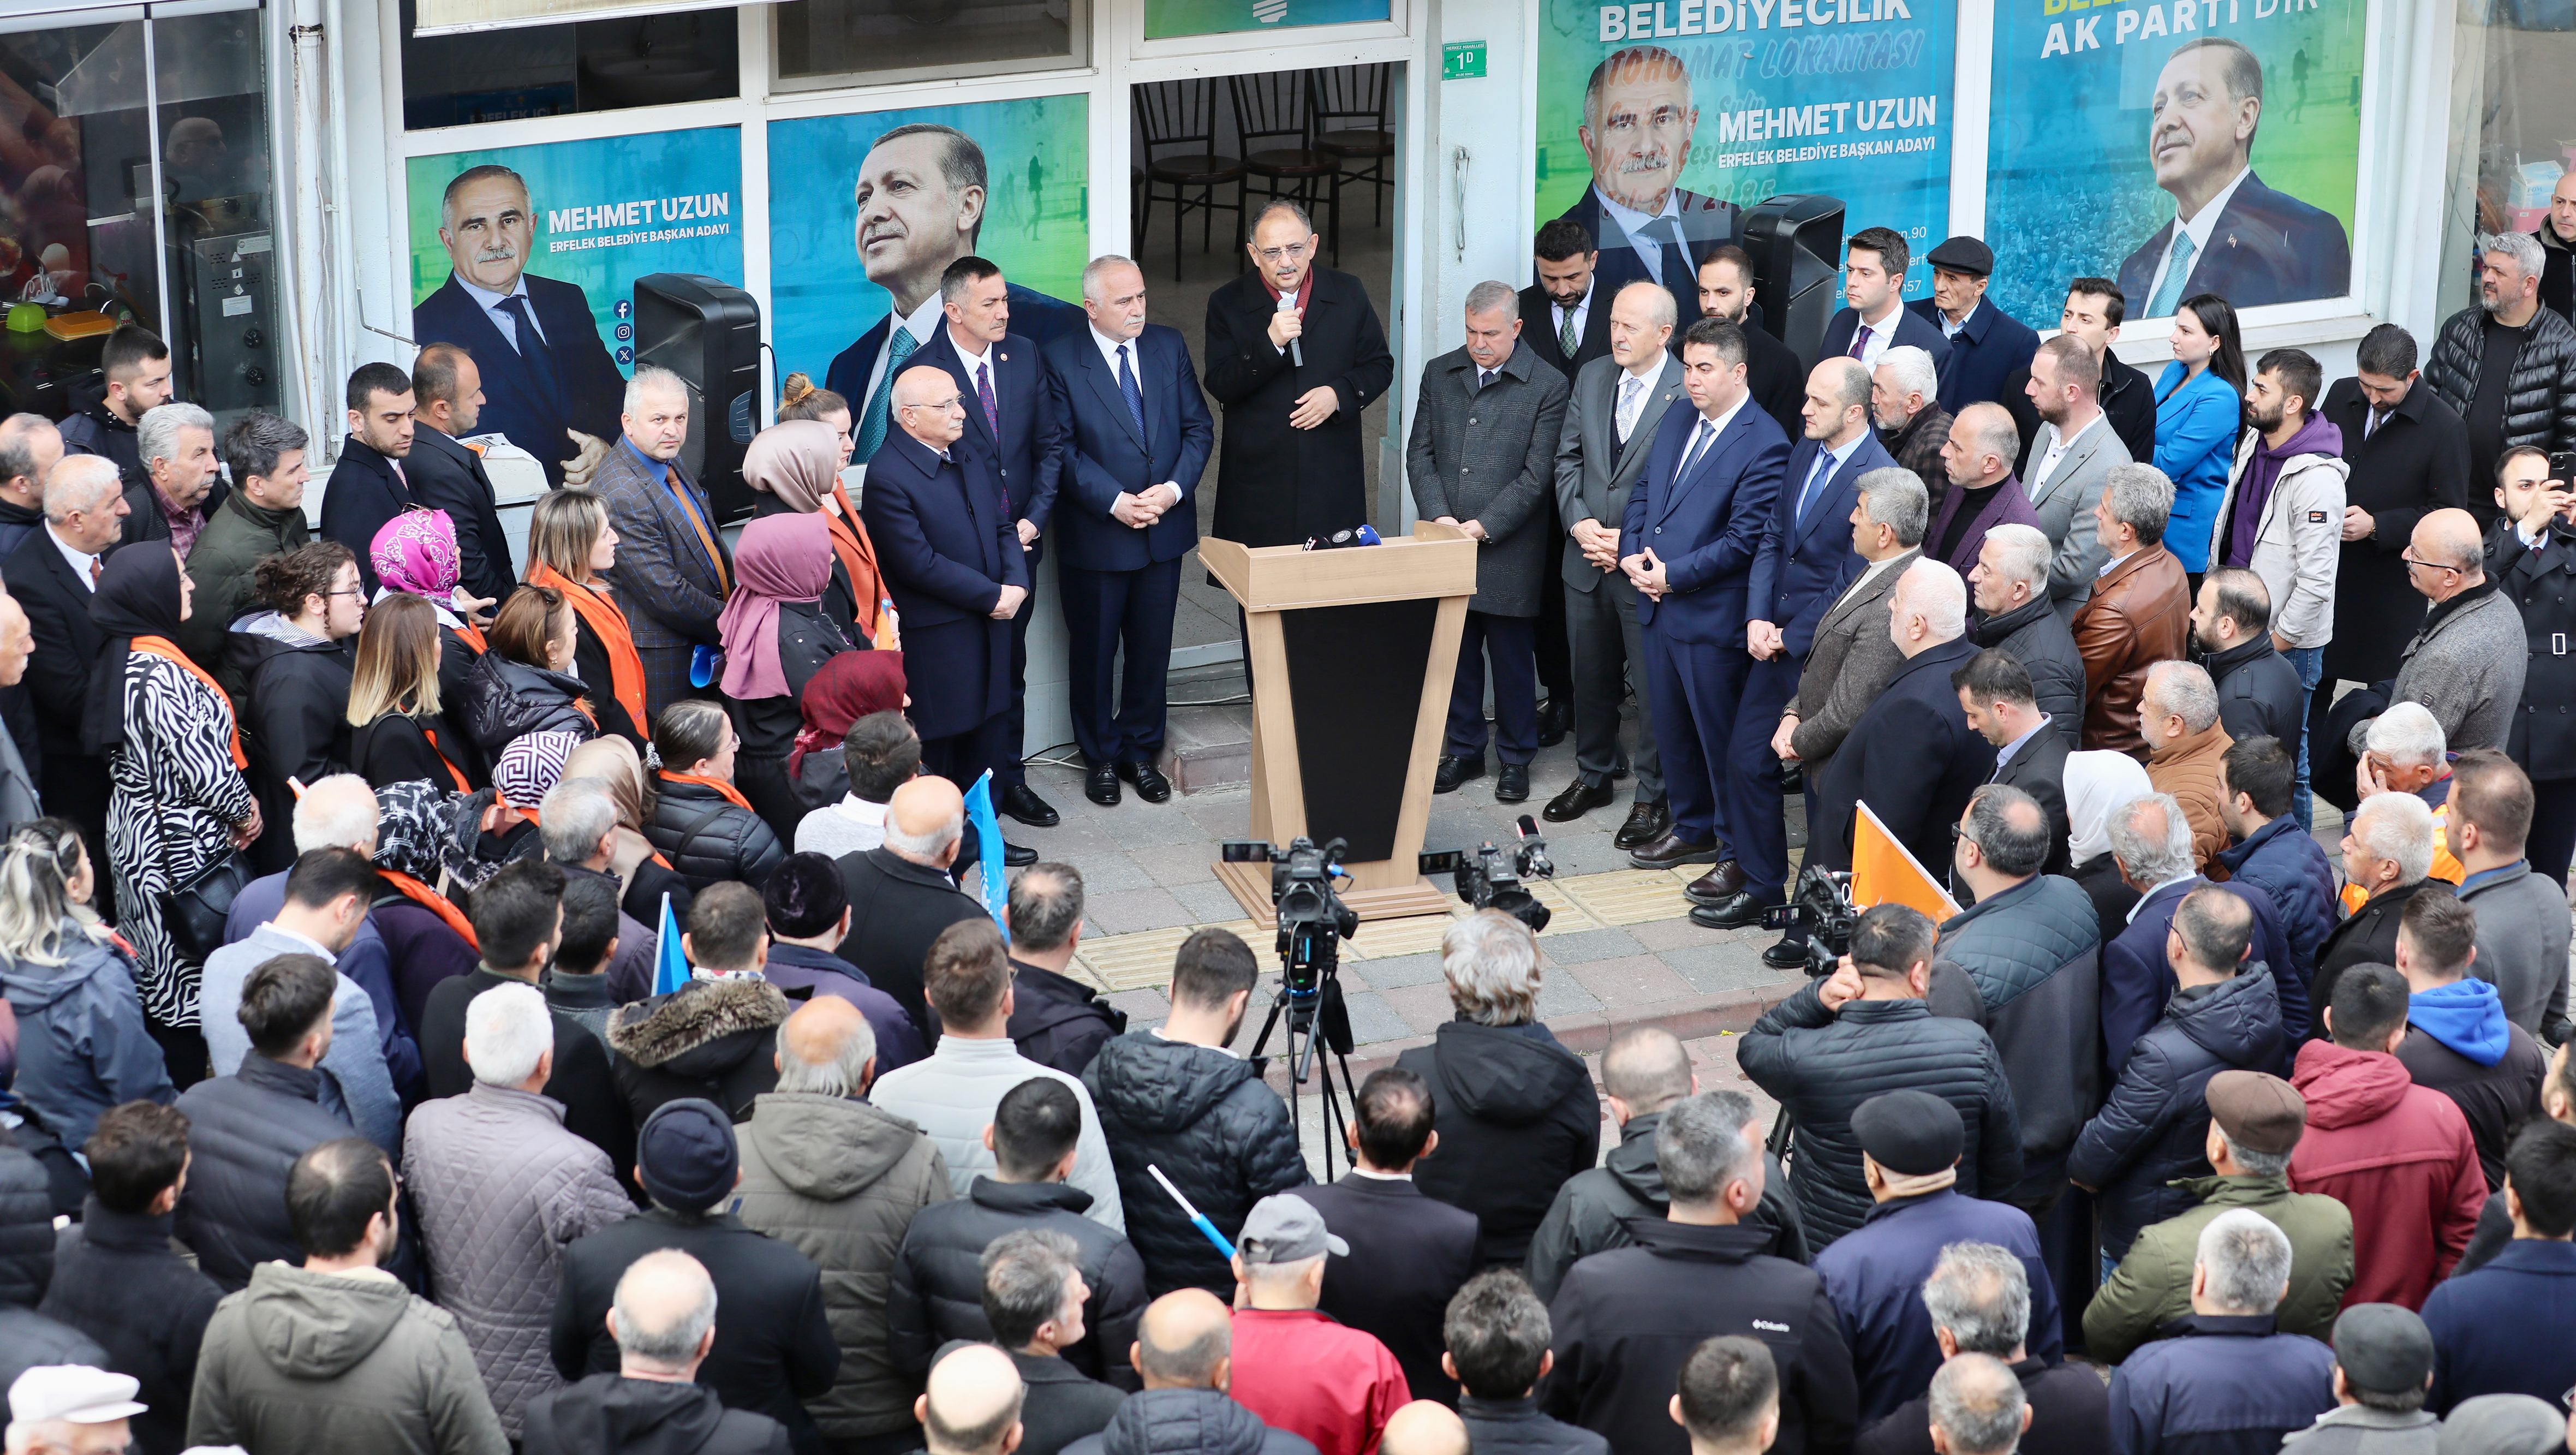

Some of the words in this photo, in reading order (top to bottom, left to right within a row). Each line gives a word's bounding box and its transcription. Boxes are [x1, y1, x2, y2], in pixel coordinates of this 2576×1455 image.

[2041, 15, 2102, 59] AK
[1720, 102, 1851, 143] MEHMET
[1857, 95, 1936, 131] UZUN
[1719, 150, 1774, 168] ERFELEK
[1776, 142, 1837, 163] BELEDİYE
[1840, 139, 1893, 160] BAŞKAN
[1895, 136, 1936, 153] ADAYI
[549, 200, 656, 234] MEHMET
[662, 192, 729, 221] UZUN
[550, 237, 595, 253] ERFELEK
[598, 230, 648, 249] BELEDİYE
[649, 227, 694, 243] BAŞKAN
[696, 223, 729, 236] ADAYI
